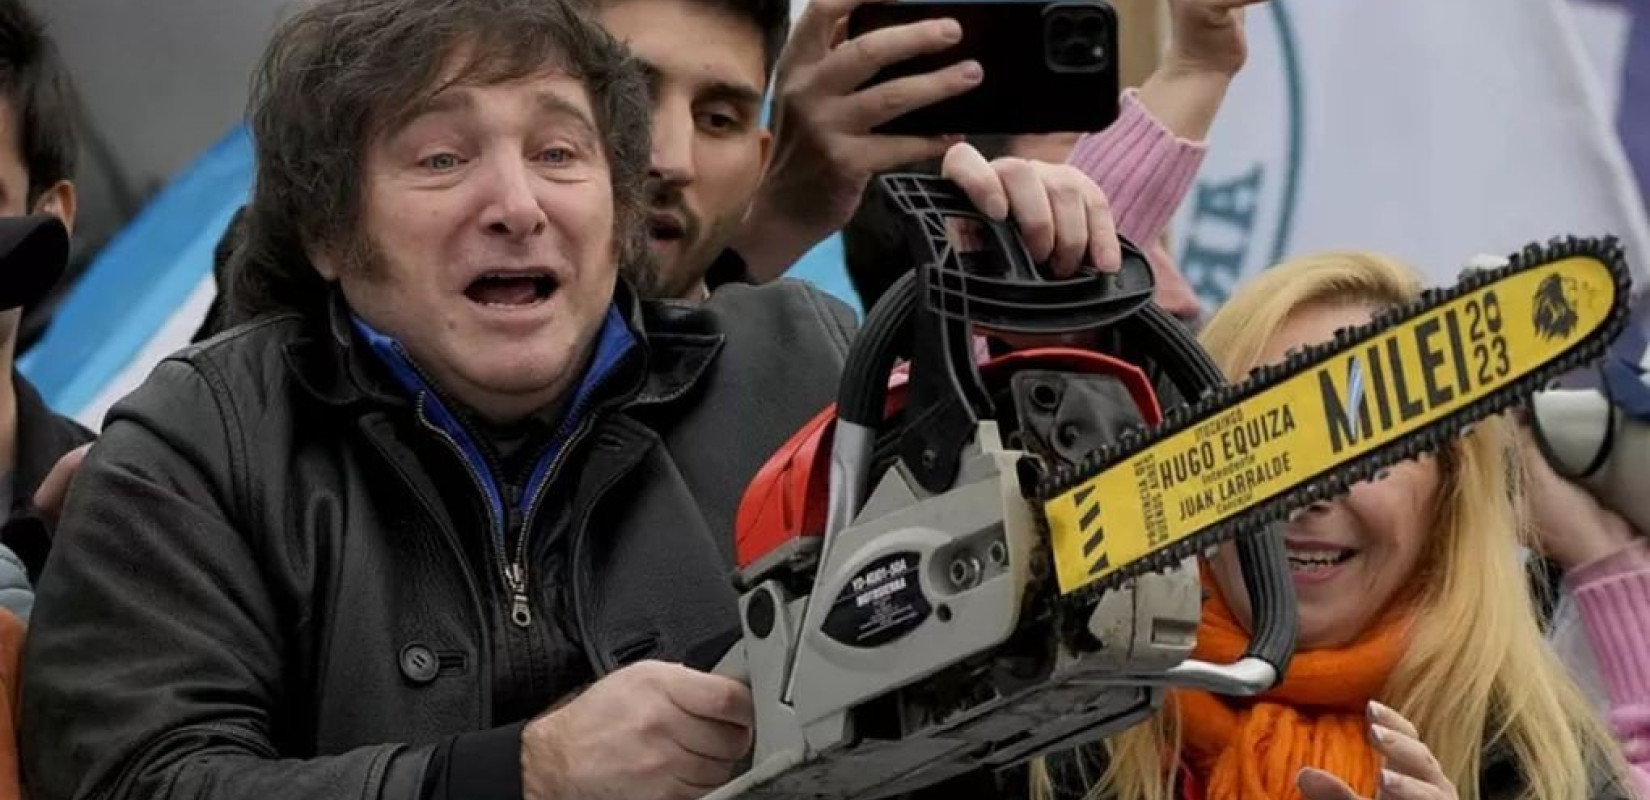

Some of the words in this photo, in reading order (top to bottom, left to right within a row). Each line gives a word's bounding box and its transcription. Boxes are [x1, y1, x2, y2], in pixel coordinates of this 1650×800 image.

[1465, 290, 1502, 343] 20
[1317, 309, 1471, 454] MILEI
[1473, 336, 1510, 386] 23
[1159, 441, 1214, 490] HUGO
[1221, 403, 1295, 460] EQUIZA
[1180, 489, 1214, 521] JUAN
[1218, 451, 1291, 500] LARRALDE
